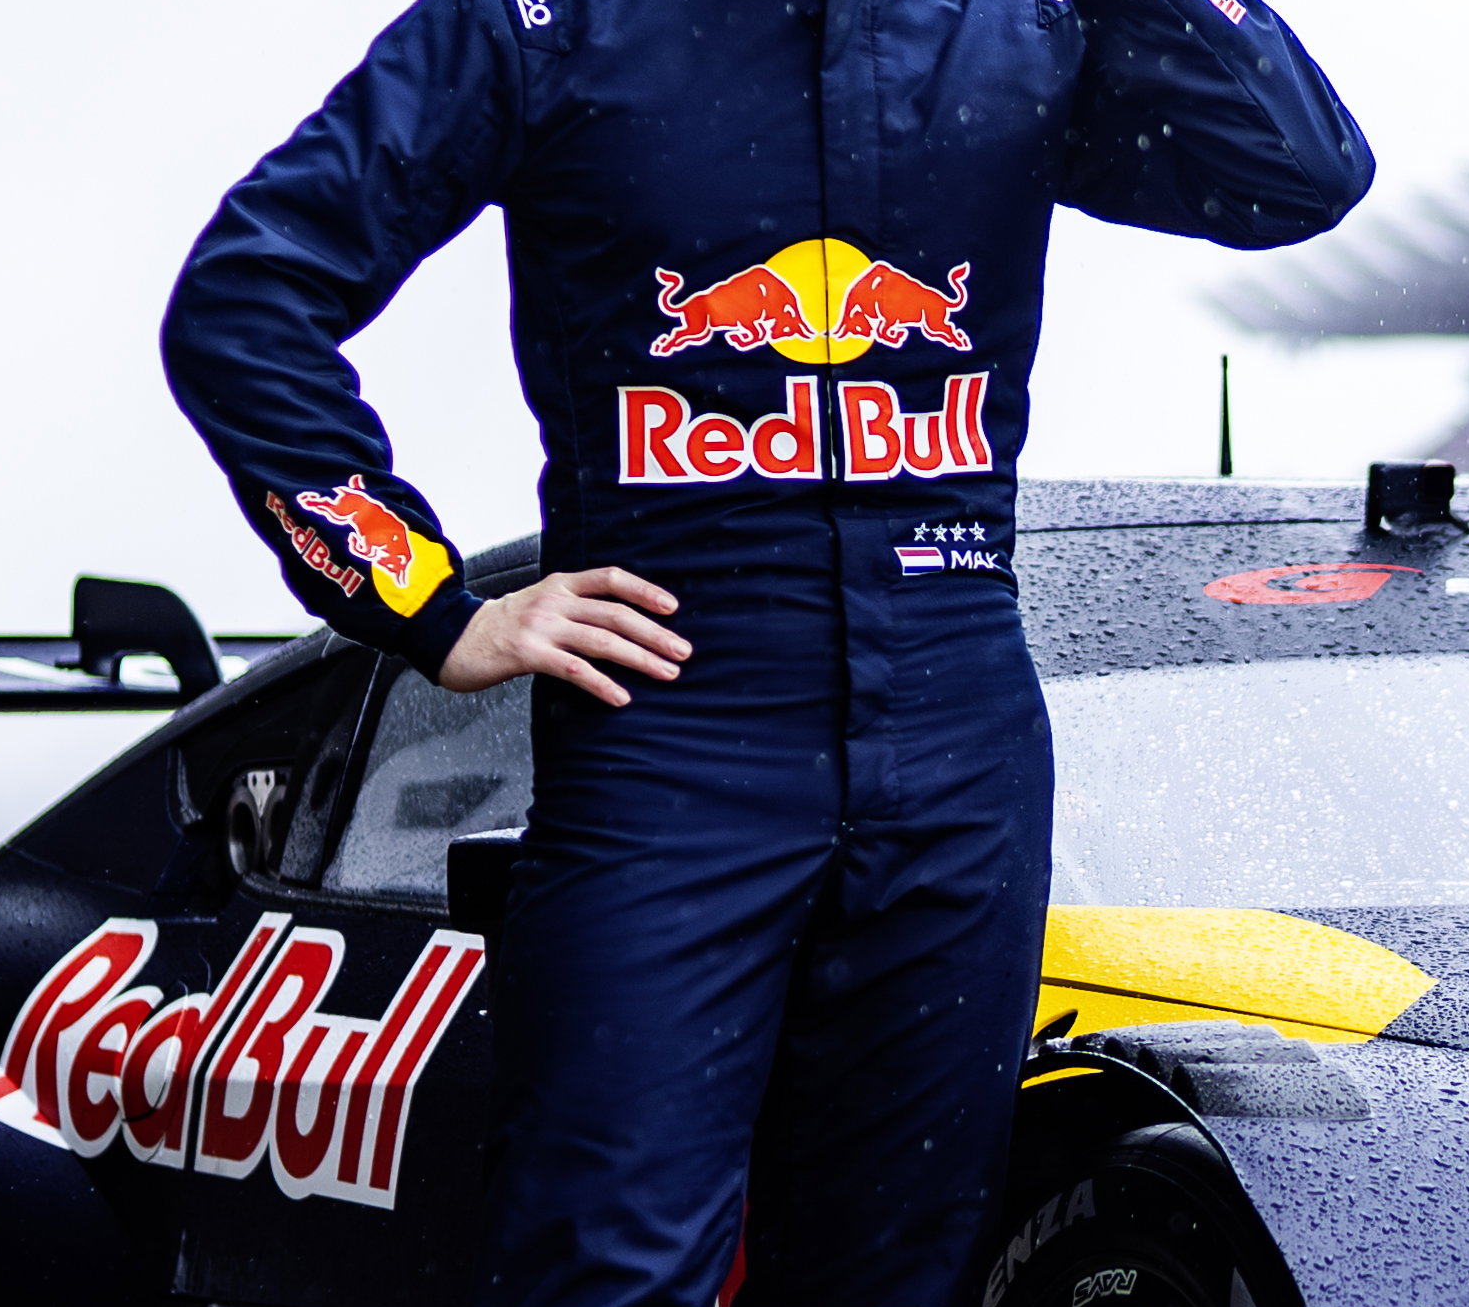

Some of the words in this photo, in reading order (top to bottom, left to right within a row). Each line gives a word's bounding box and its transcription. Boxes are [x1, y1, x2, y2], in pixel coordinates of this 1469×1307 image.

[617, 374, 822, 485] Red
[841, 370, 994, 477] Bull
[266, 490, 317, 555] Red
[302, 537, 365, 598] Bull
[194, 925, 486, 1211] Bull
